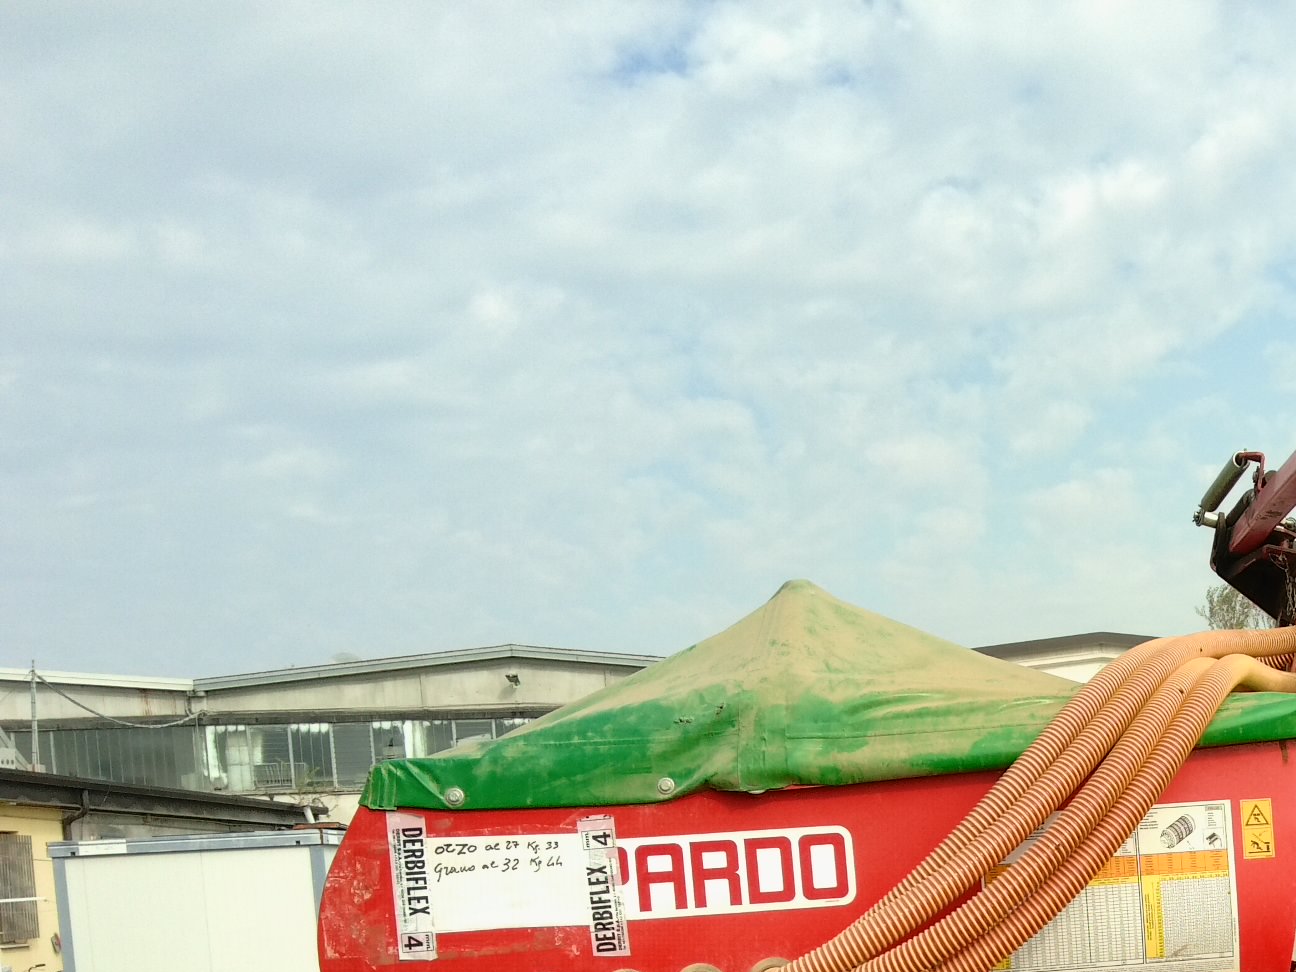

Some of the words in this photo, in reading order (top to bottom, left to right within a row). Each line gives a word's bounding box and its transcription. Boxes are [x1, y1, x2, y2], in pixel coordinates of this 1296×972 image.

[505, 840, 520, 850] 27
[545, 841, 560, 850] 33
[591, 831, 611, 846] 4
[401, 827, 431, 917] DERBIFLEX
[433, 862, 476, 882] Grano
[501, 857, 520, 873] 32
[586, 865, 617, 953] DERBIFLEX
[404, 935, 424, 950] 4
